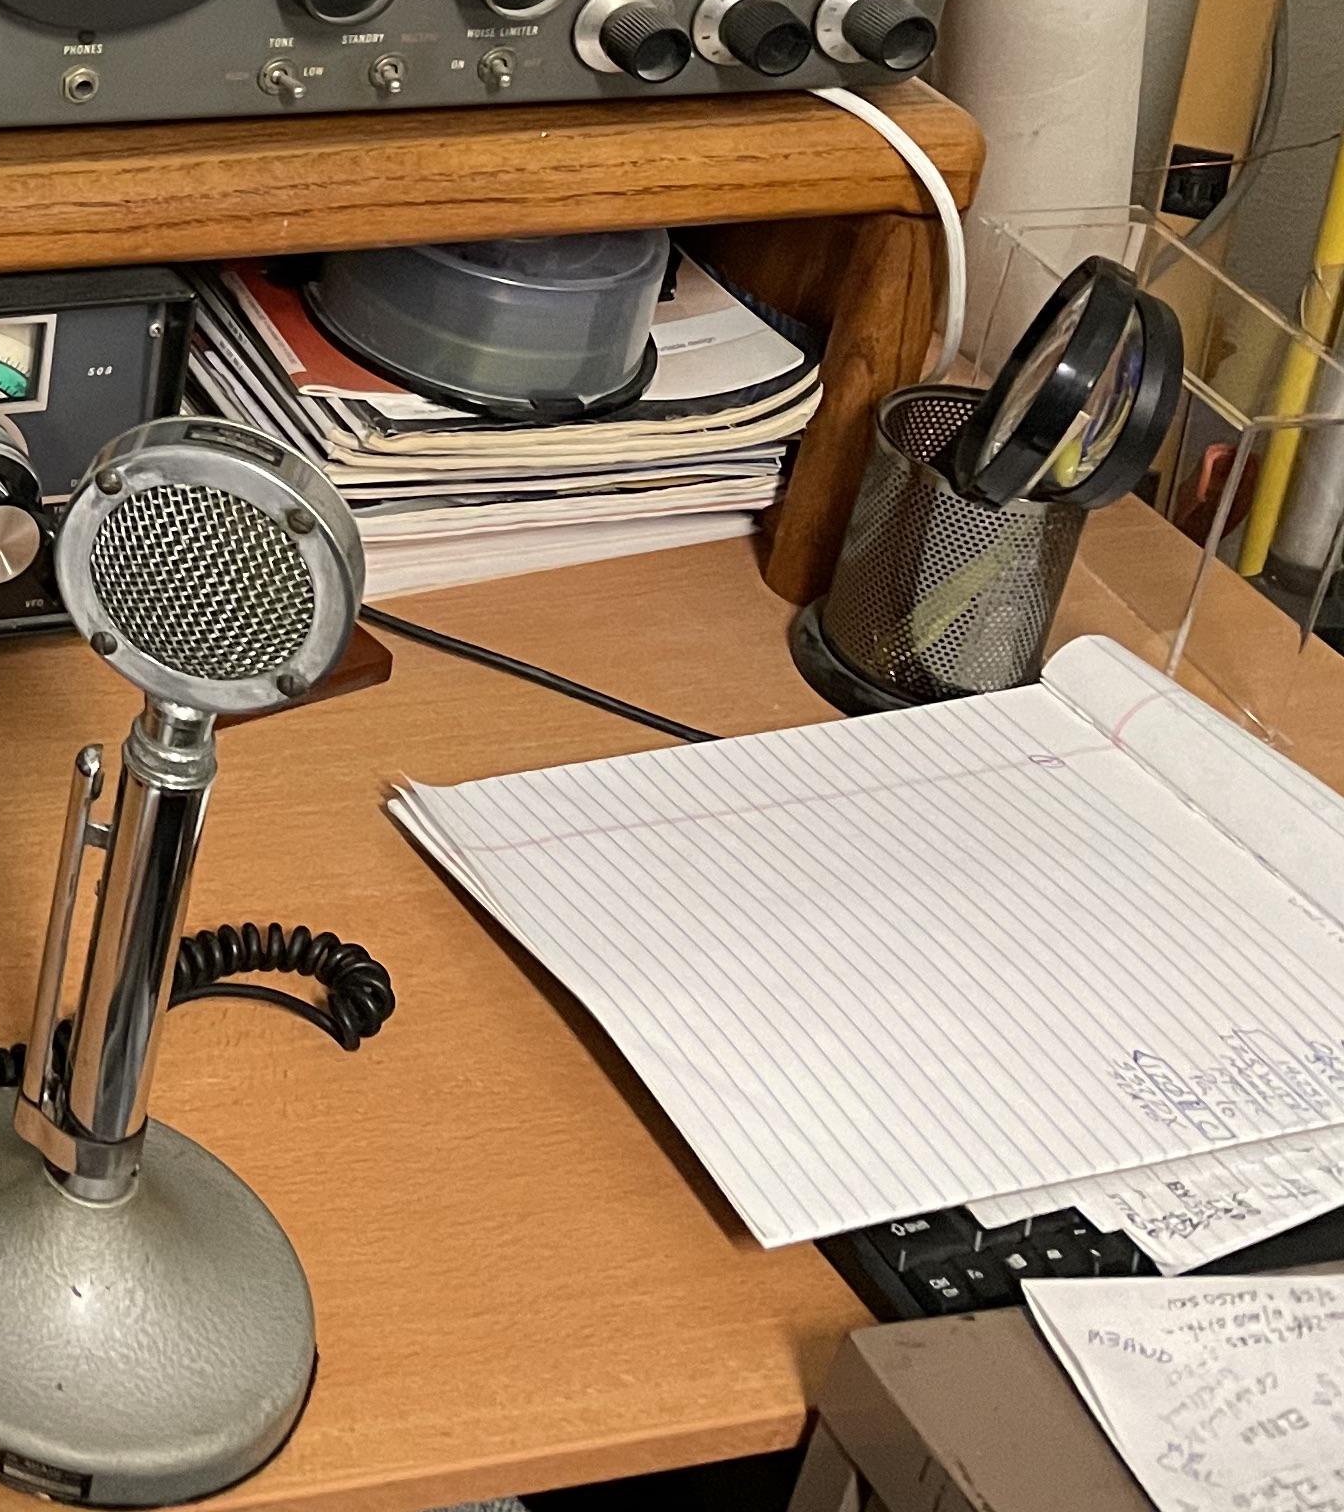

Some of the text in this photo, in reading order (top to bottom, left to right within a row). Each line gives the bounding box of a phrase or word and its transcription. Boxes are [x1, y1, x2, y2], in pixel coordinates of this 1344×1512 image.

[467, 25, 539, 39] NOISE LIMITER
[269, 37, 295, 49] TONE
[342, 33, 384, 45] STANDBY
[63, 44, 103, 56] PHONES
[303, 66, 324, 77] LOW
